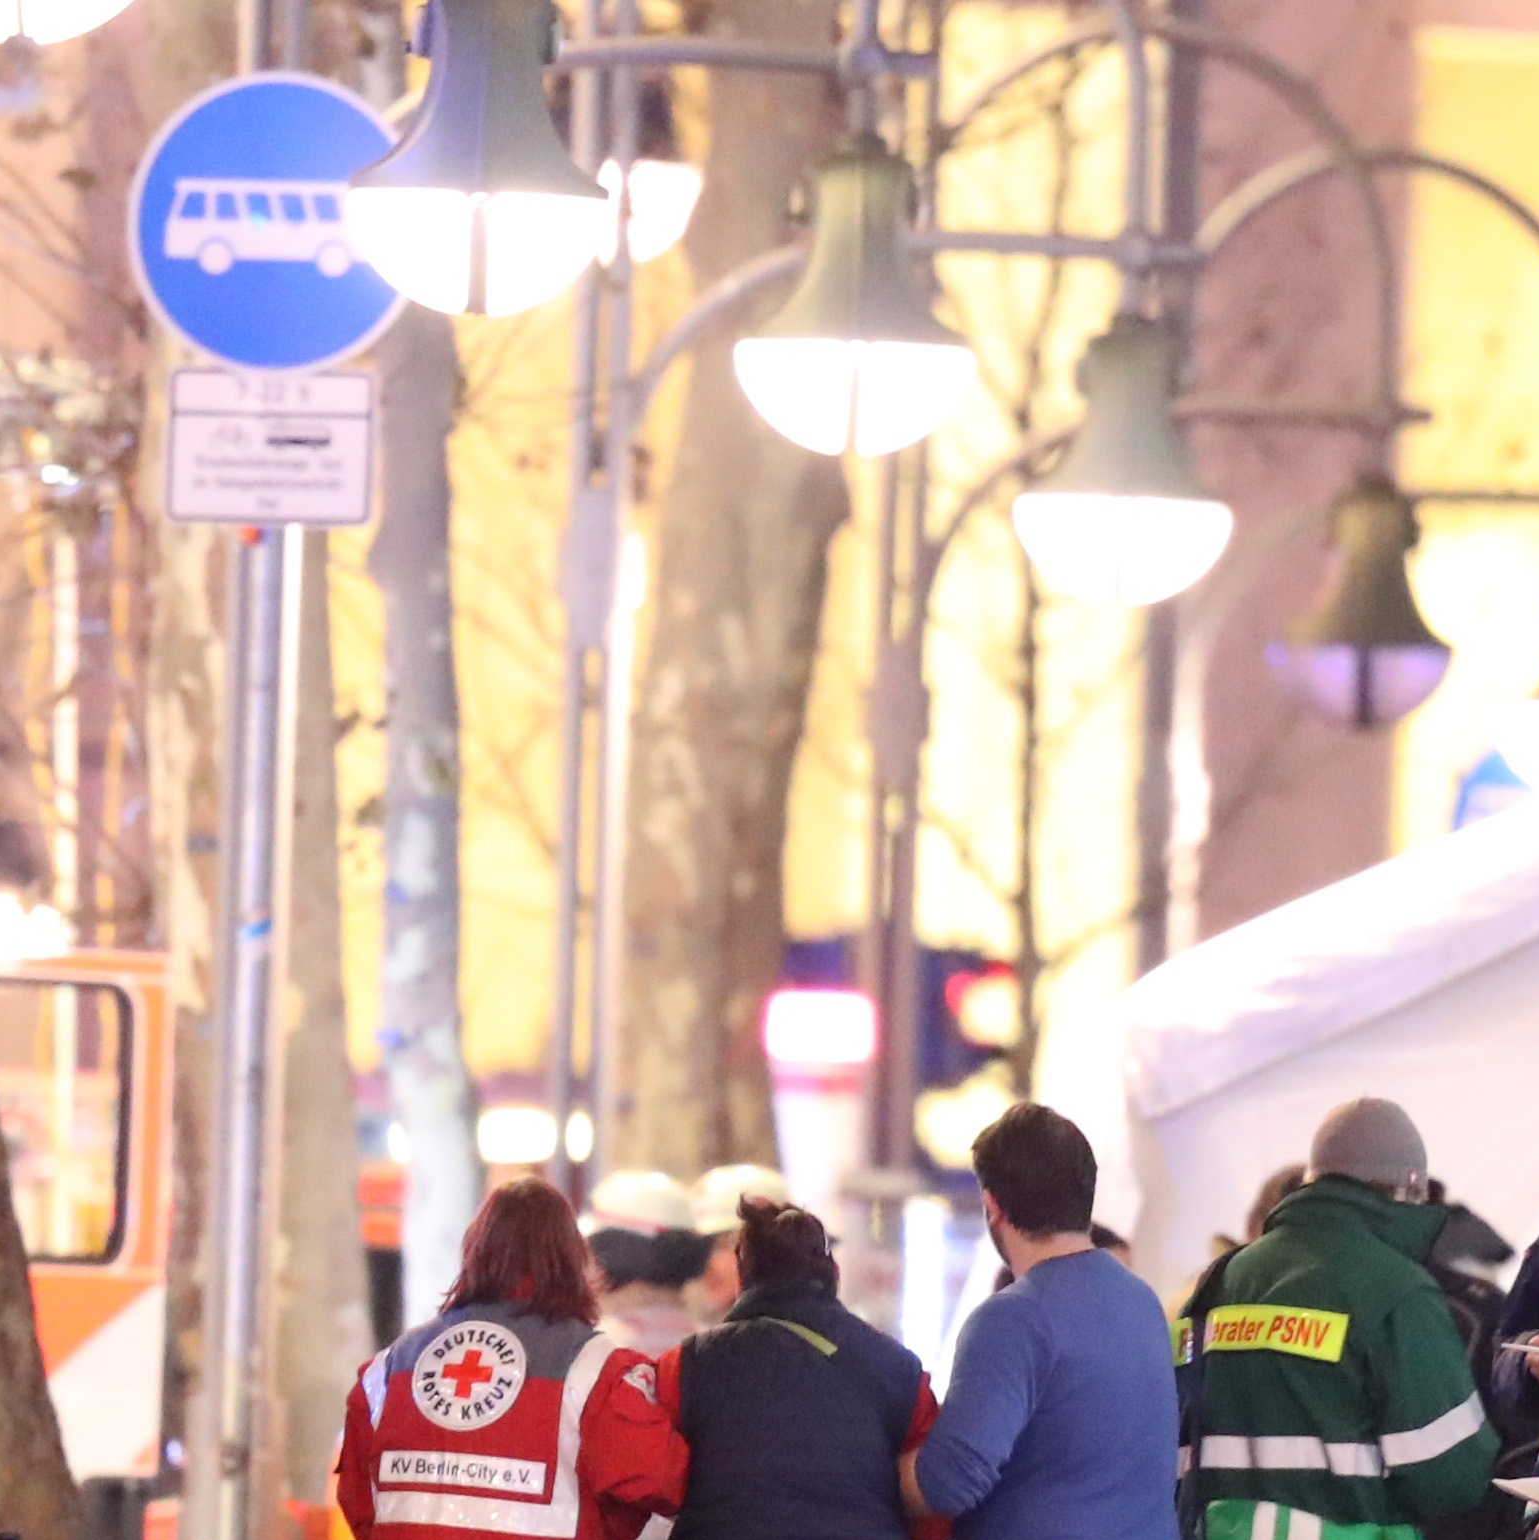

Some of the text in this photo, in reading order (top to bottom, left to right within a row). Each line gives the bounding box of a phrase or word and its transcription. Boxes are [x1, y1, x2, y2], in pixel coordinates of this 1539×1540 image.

[434, 1330, 515, 1365] DEUTSCHES
[1266, 1314, 1331, 1349] PSNV
[423, 1371, 452, 1416] ROTES
[461, 1378, 512, 1420] KREUZ
[391, 1457, 411, 1474] KV
[415, 1458, 498, 1483] Berlin-City
